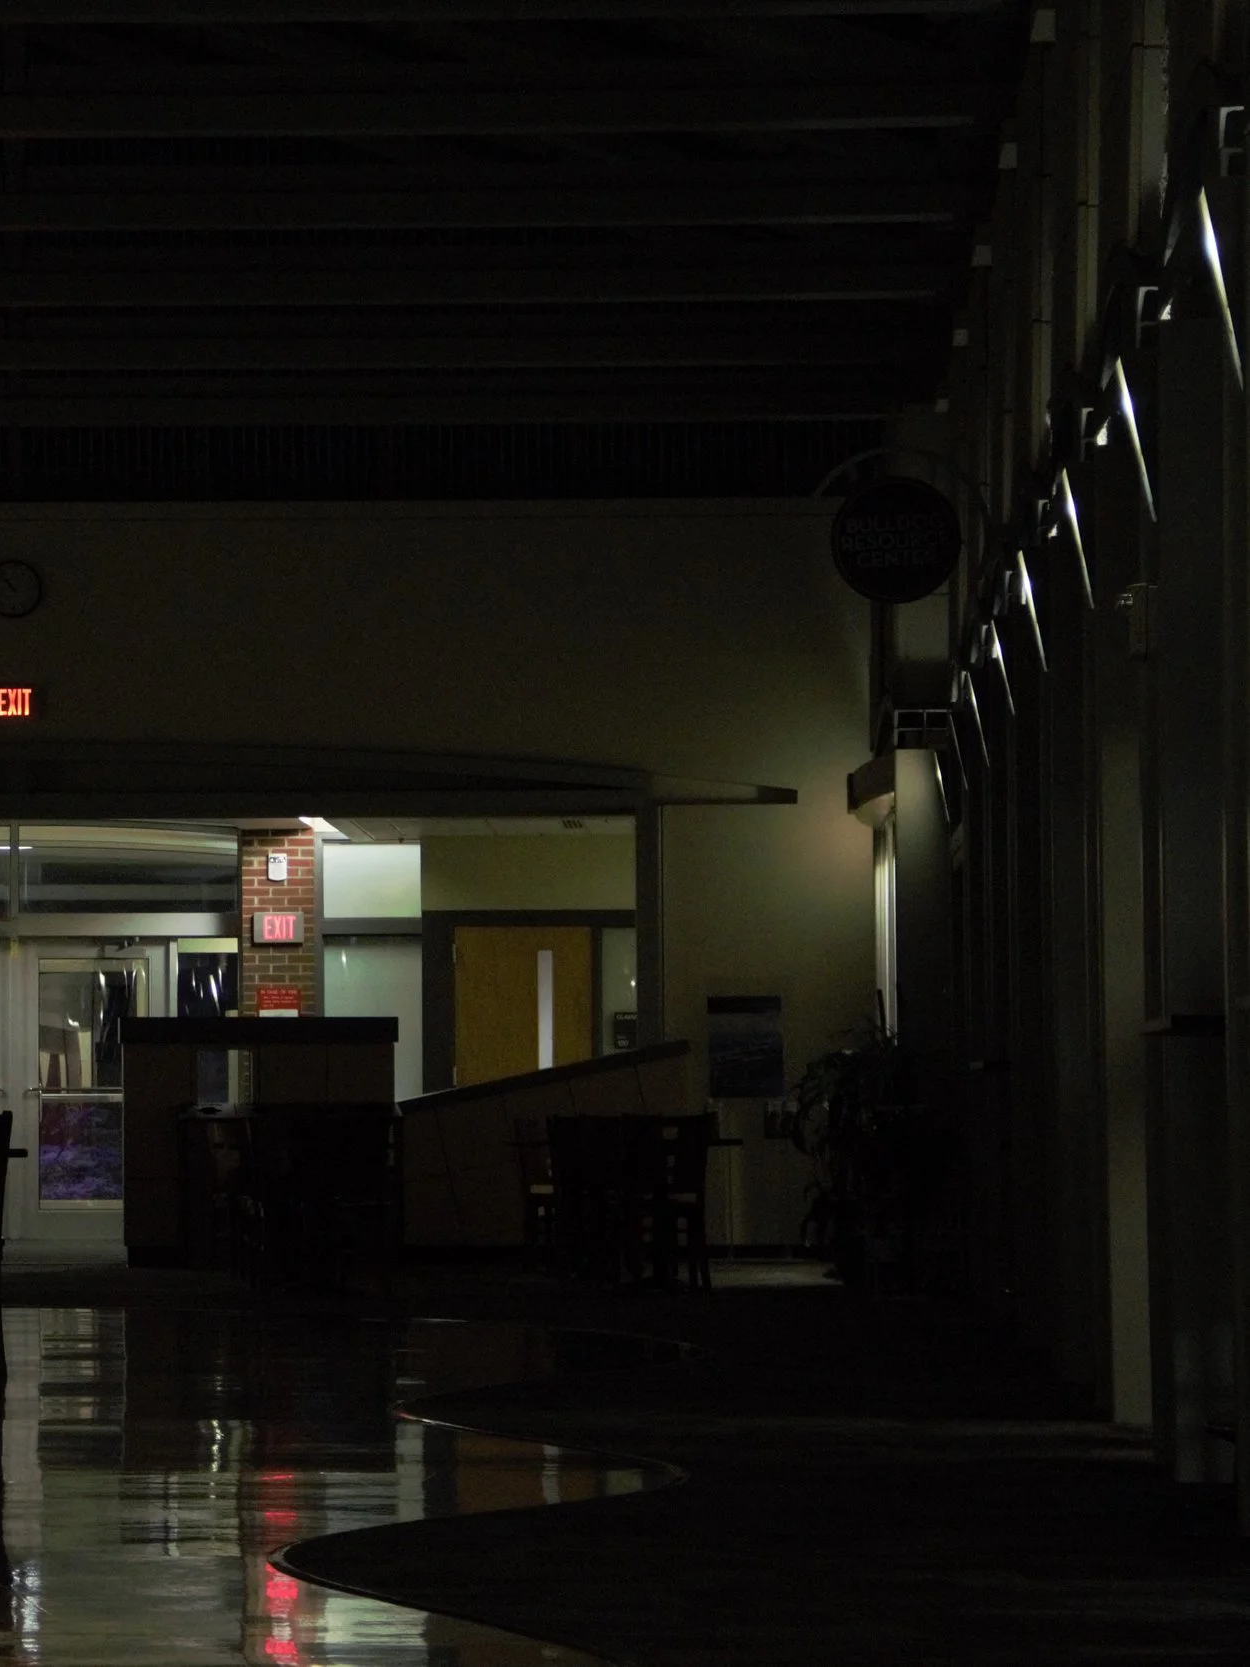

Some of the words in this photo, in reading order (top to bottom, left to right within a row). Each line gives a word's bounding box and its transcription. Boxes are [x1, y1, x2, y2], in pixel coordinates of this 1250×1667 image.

[846, 513, 945, 533] BULLDOG
[841, 530, 951, 551] RESOURCE
[263, 915, 296, 940] EXIT
